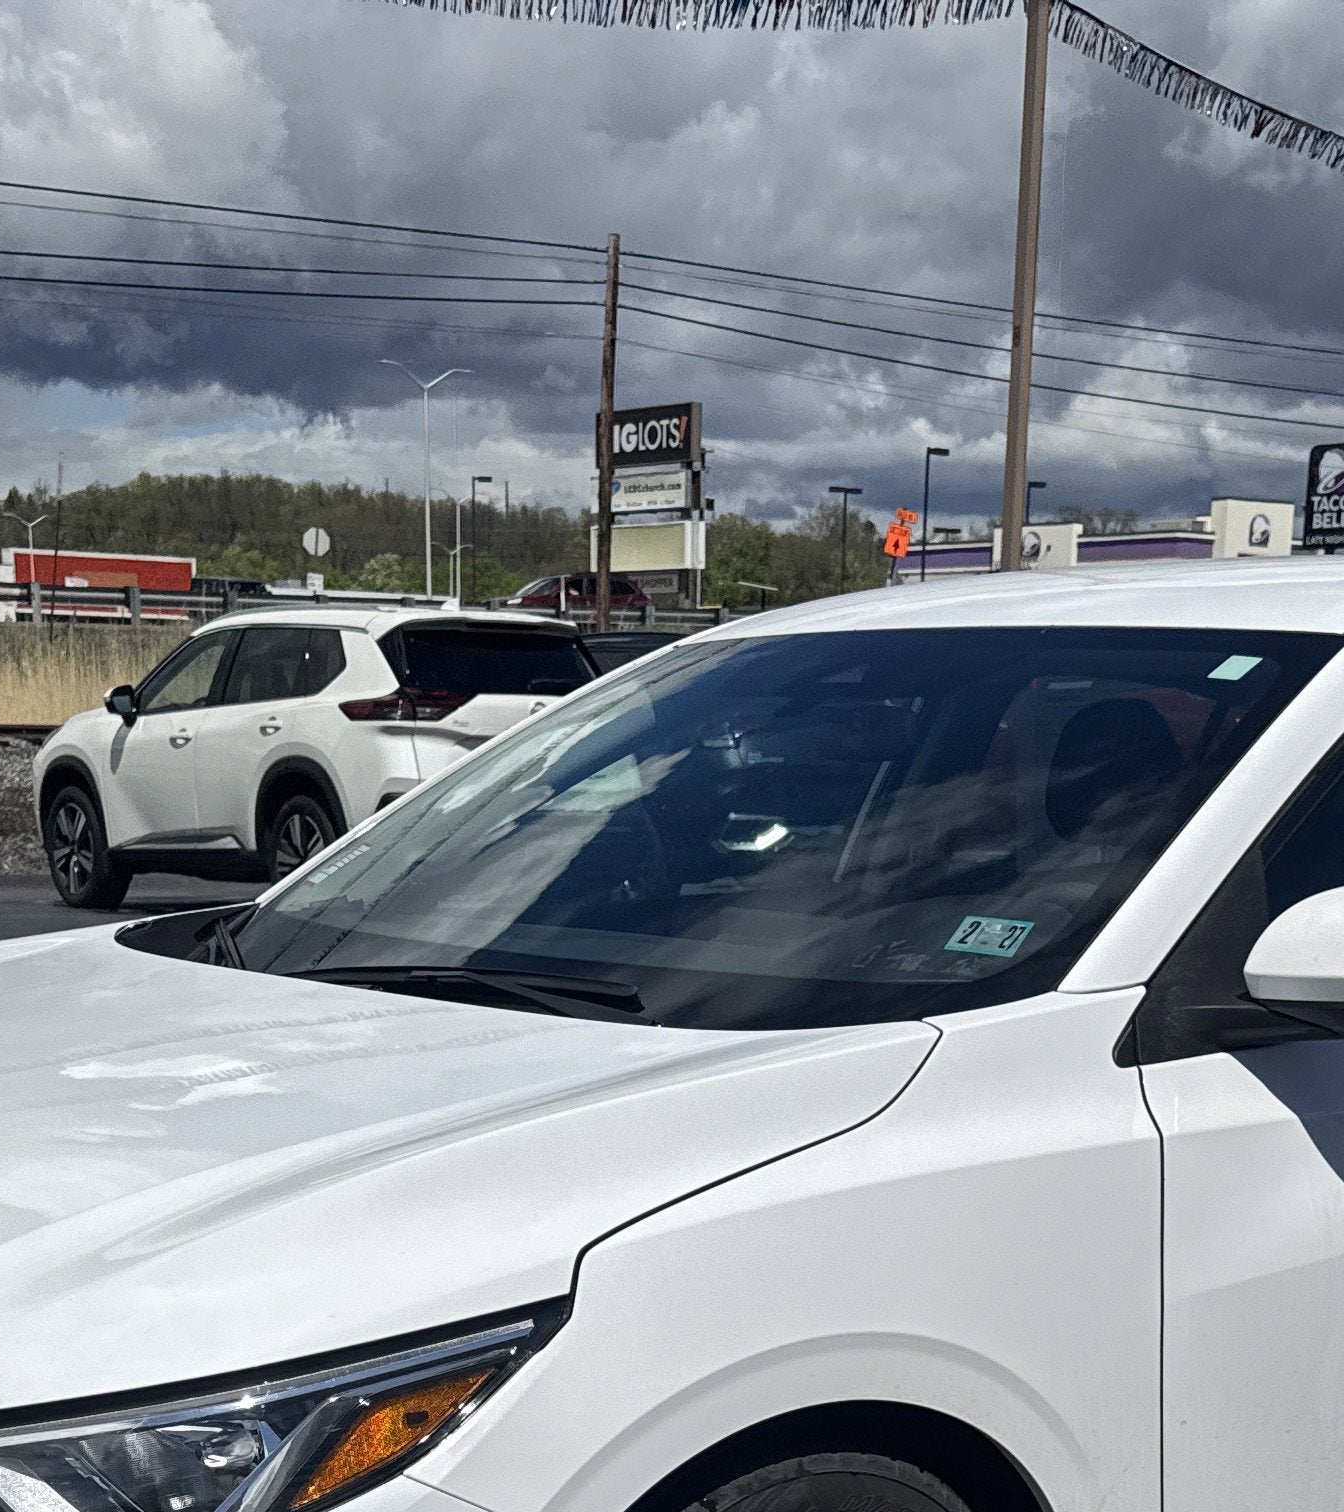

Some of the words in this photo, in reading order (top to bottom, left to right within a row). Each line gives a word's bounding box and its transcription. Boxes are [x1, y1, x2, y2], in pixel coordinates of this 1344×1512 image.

[612, 416, 689, 454] IGLOTS!
[957, 921, 982, 944] 2
[998, 925, 1027, 951] 27
